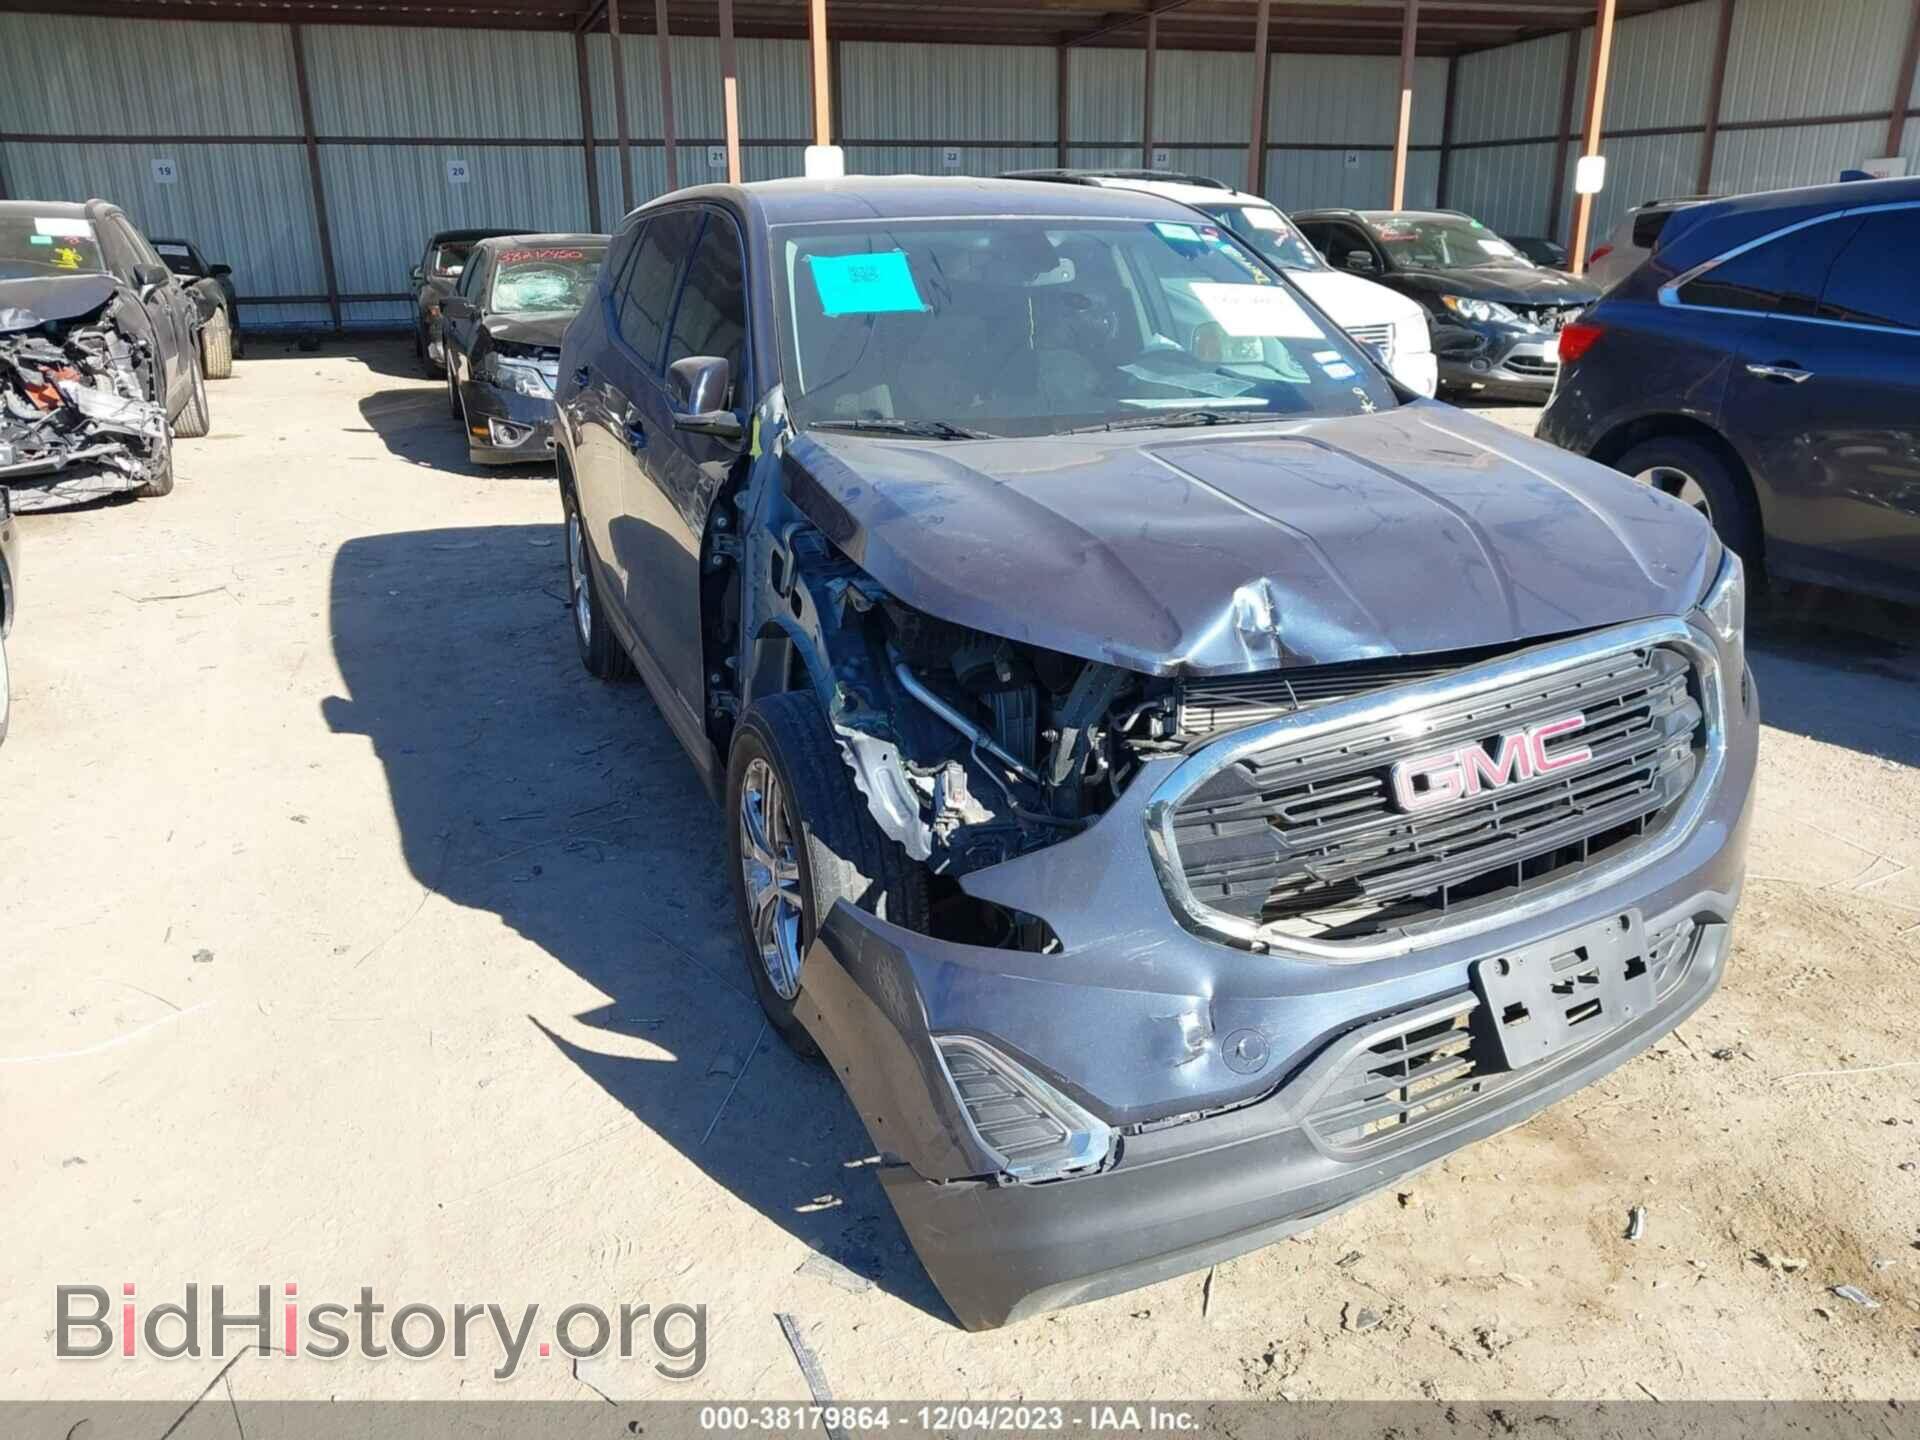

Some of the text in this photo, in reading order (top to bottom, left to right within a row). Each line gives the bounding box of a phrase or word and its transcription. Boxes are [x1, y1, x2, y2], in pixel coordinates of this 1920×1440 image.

[711, 151, 723, 161] 21
[157, 166, 171, 176] 19
[451, 167, 465, 177] 20
[1392, 711, 1592, 812] GMC
